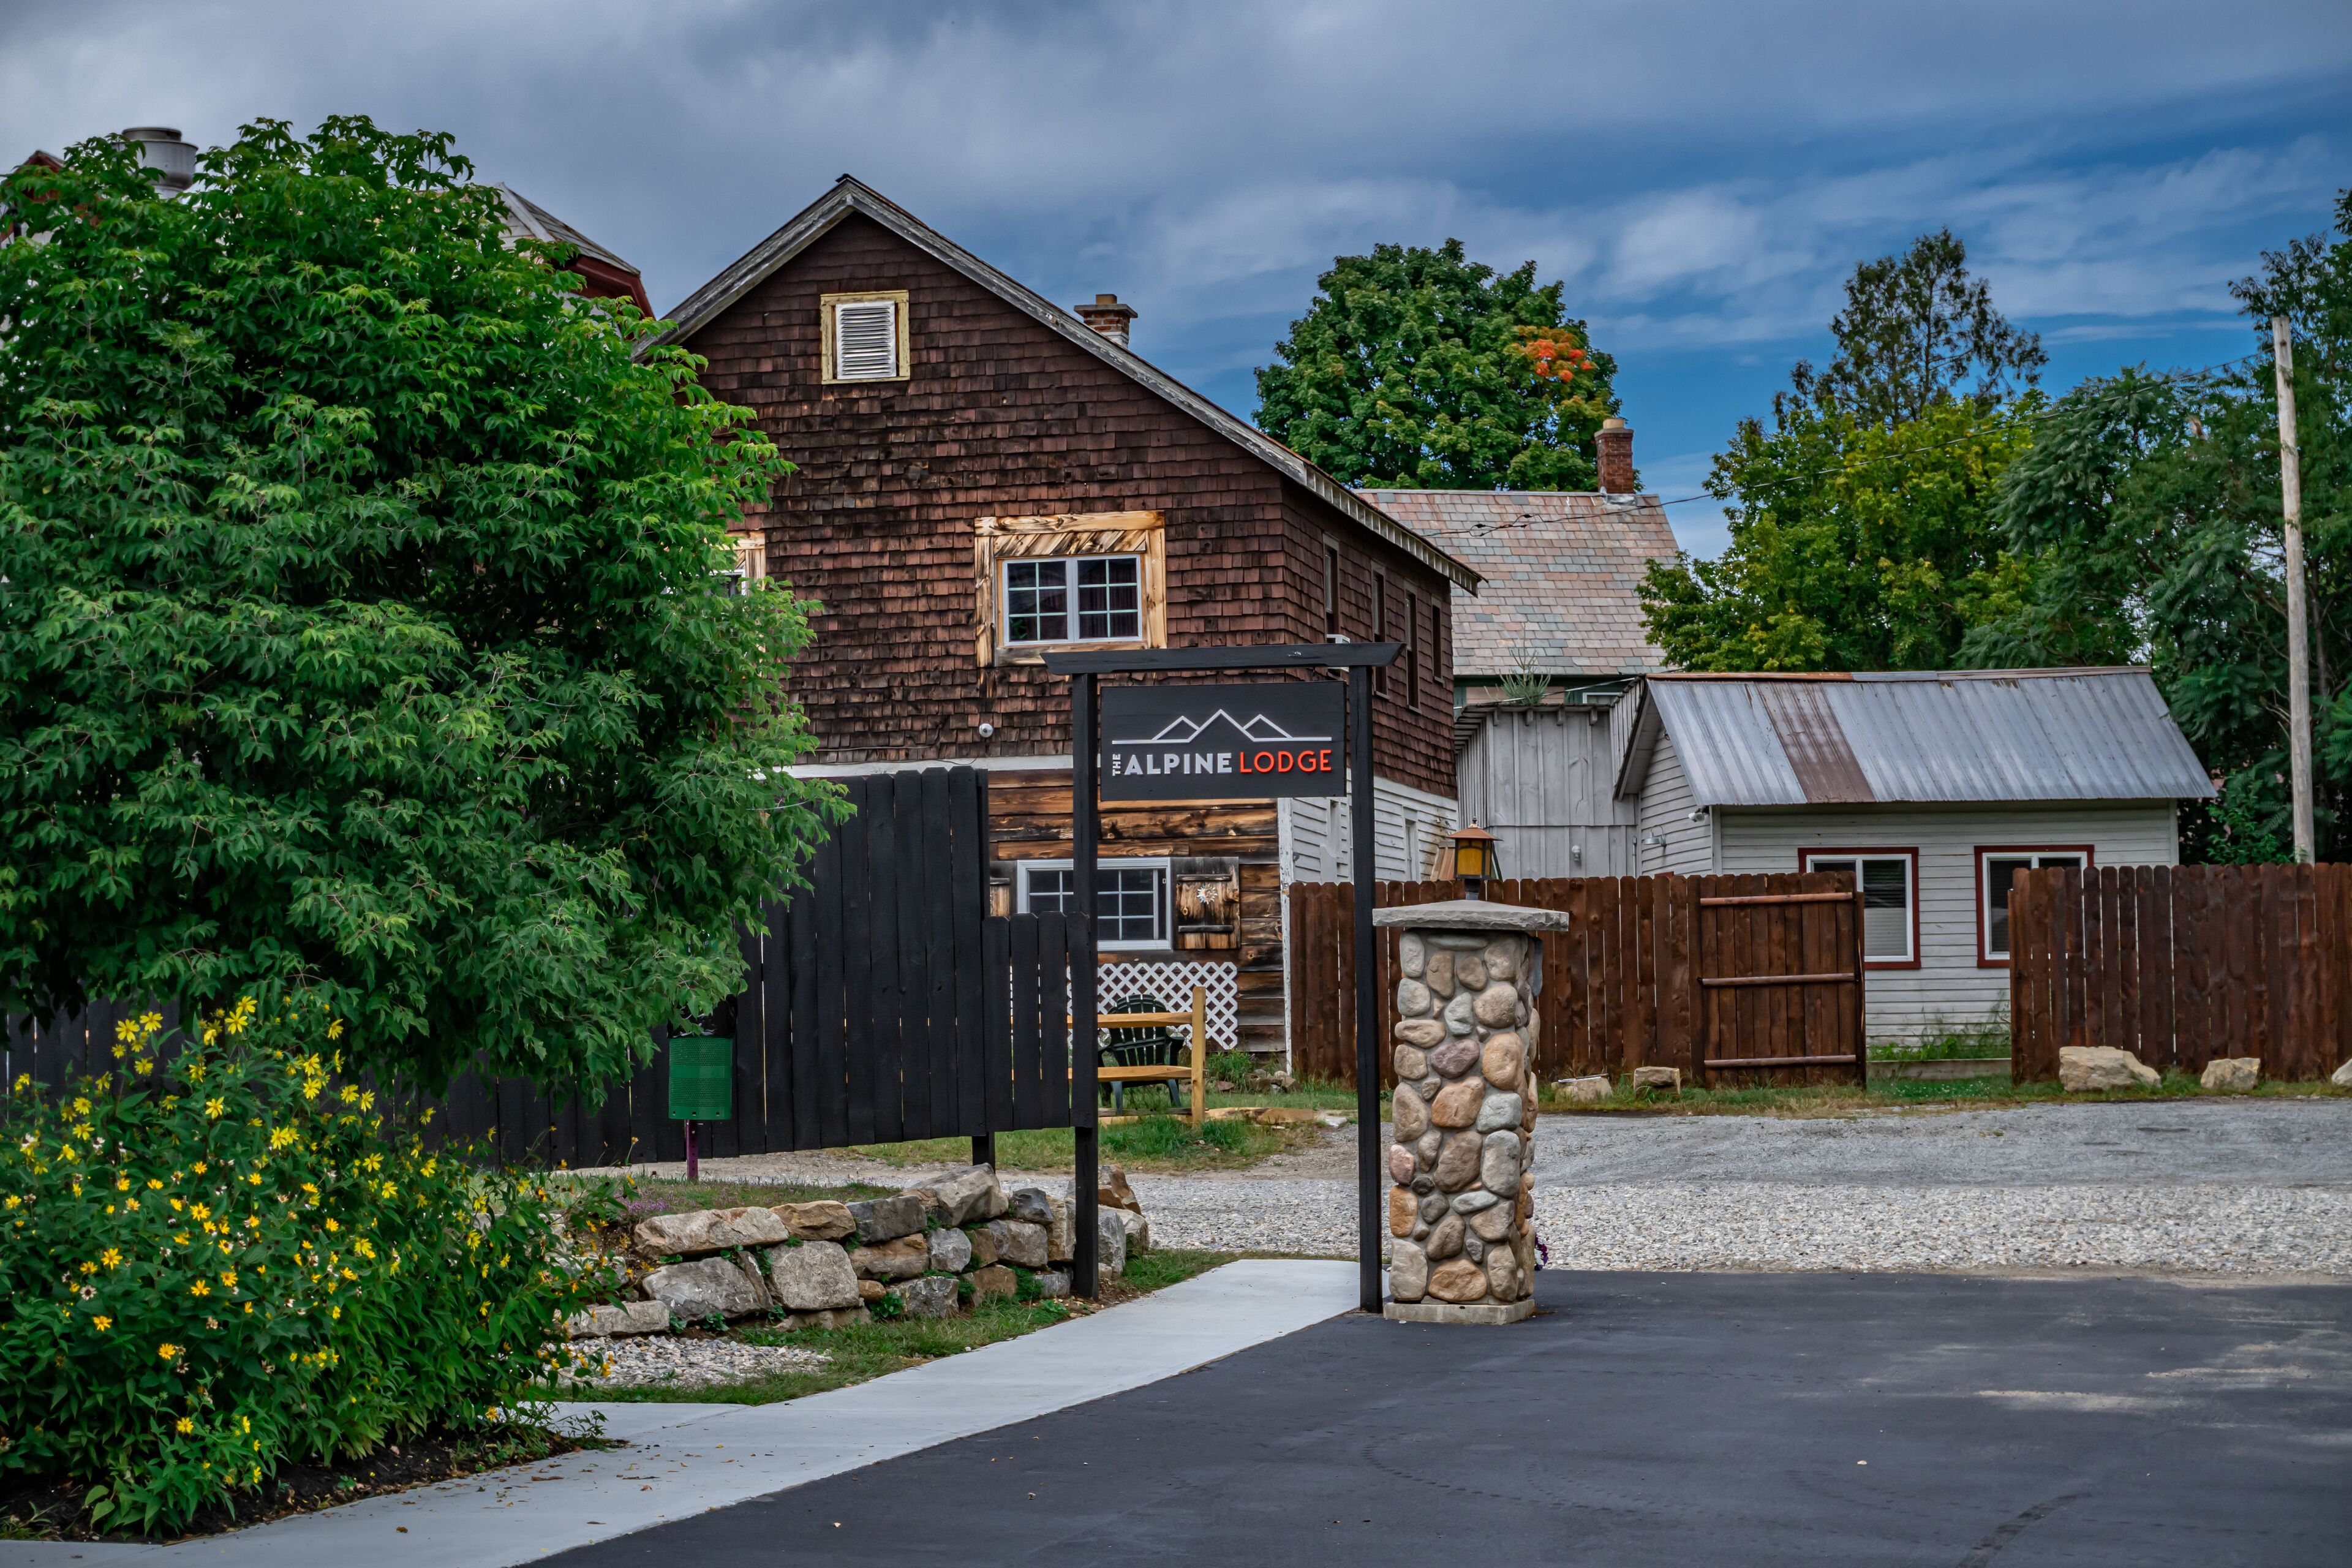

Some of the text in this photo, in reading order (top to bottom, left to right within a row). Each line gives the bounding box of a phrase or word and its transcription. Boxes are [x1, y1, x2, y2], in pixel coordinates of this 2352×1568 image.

[1112, 749, 1332, 776] THE ALPINE LODGE
